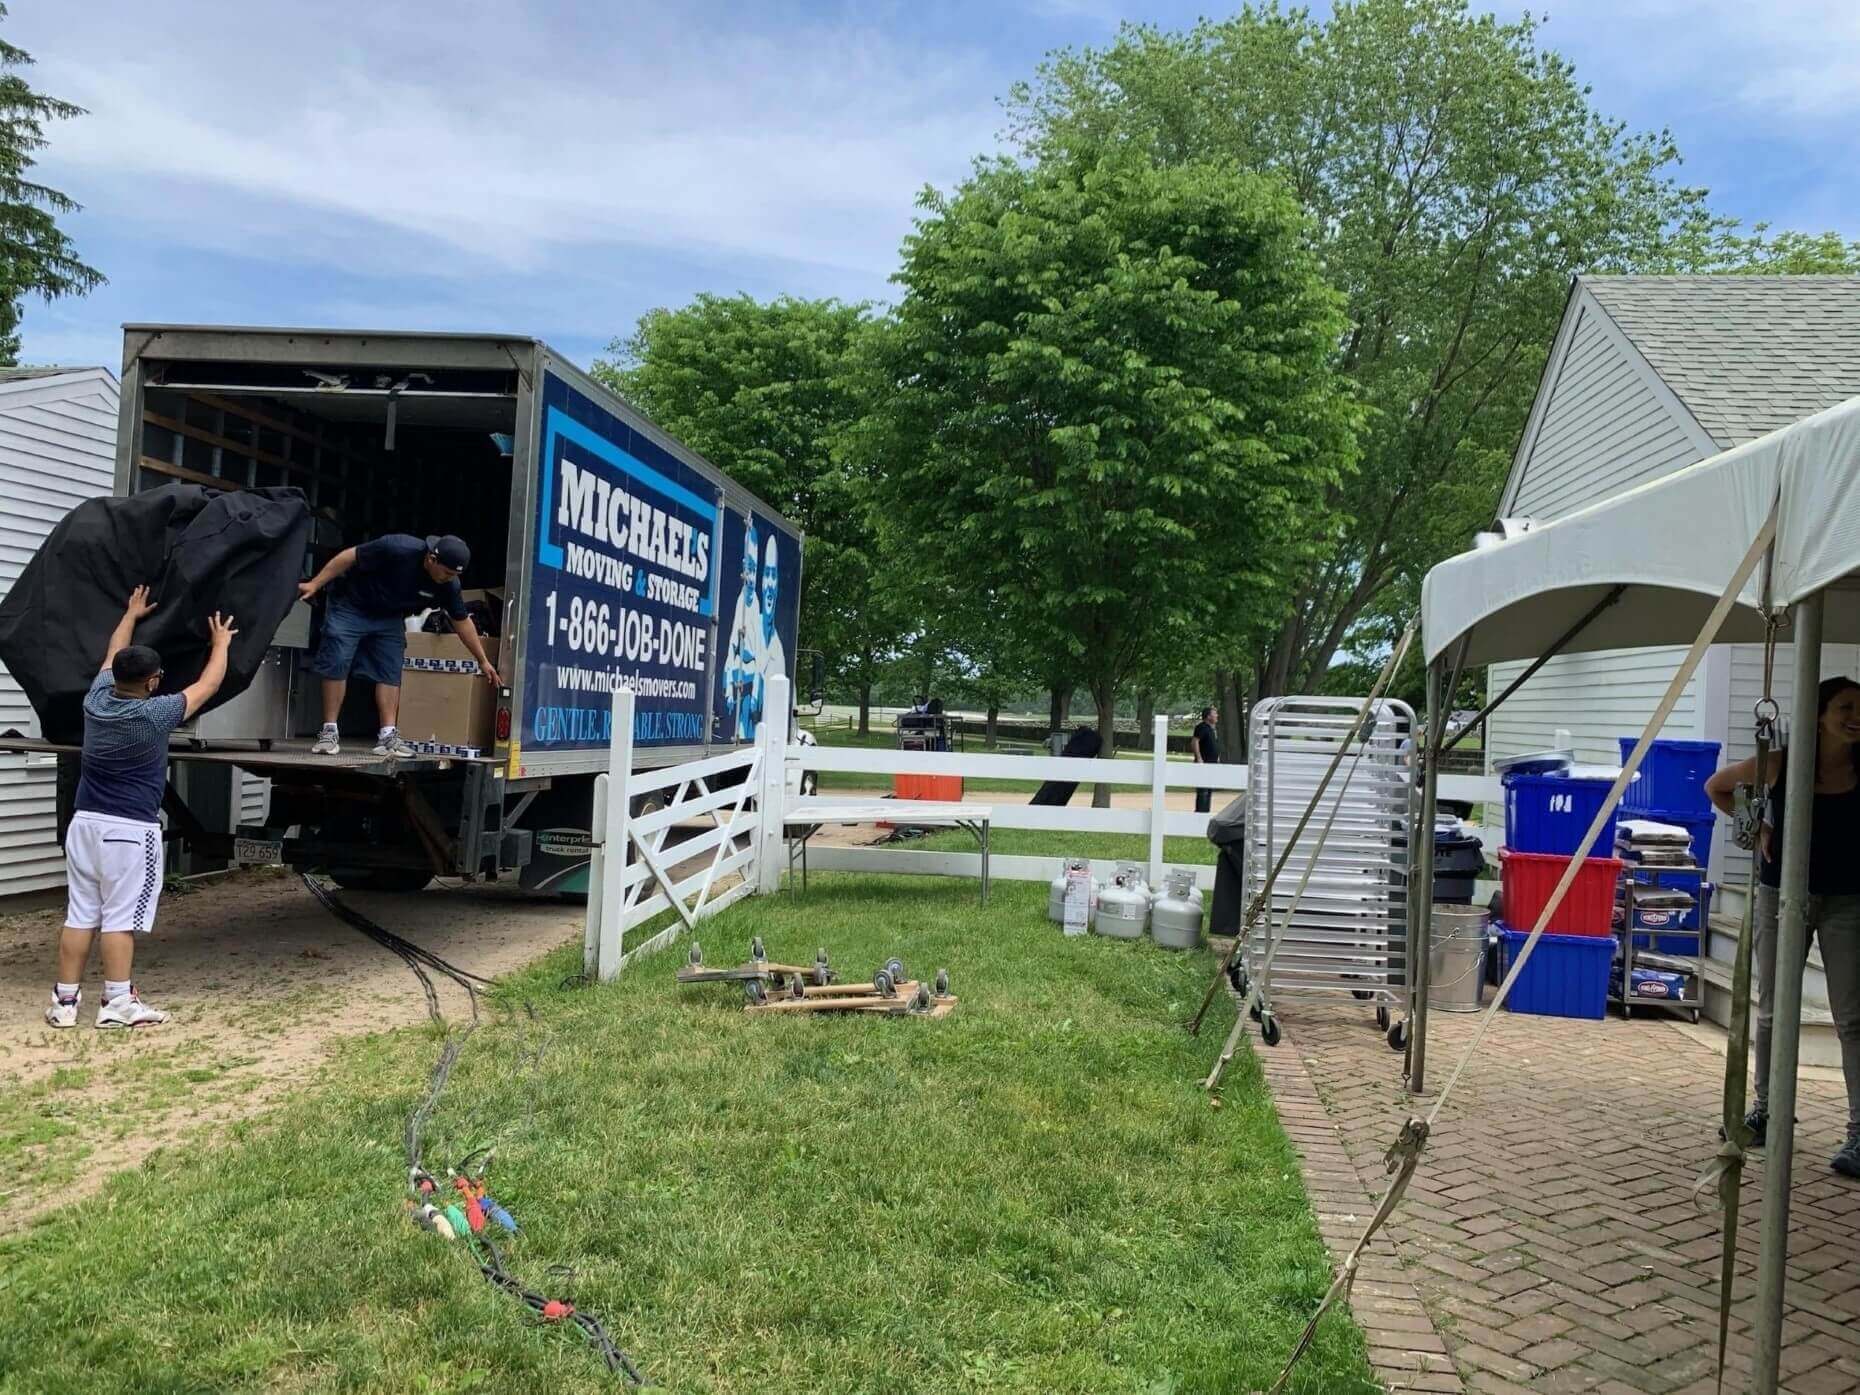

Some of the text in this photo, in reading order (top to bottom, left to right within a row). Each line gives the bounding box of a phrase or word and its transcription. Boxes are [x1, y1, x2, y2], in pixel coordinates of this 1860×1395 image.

[566, 541, 700, 613] MOVING & STORAGE
[546, 590, 706, 671] 1-866-JOB-DONE
[557, 665, 696, 700] www.michaelsmovers.com
[666, 712, 704, 740] STRONG
